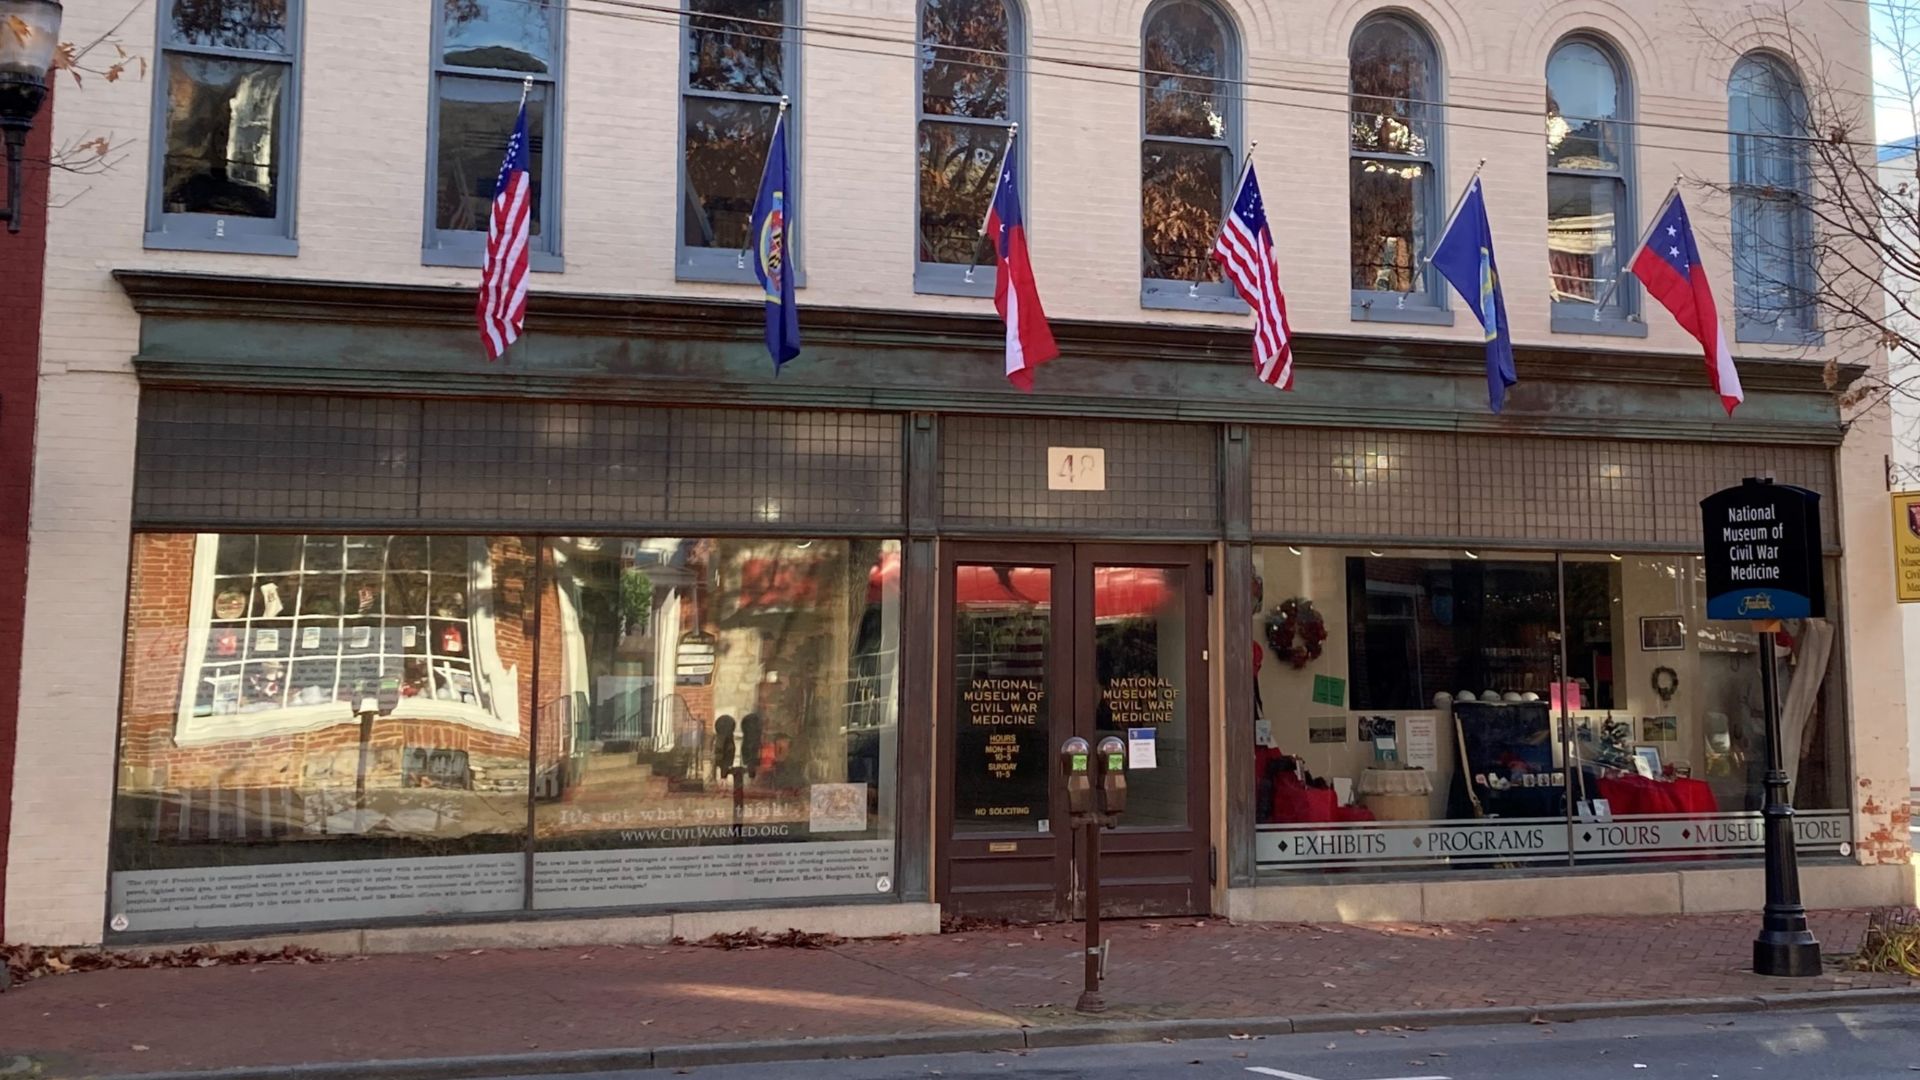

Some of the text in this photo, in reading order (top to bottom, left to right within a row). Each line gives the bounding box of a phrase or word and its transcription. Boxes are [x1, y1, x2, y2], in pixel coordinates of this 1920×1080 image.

[1729, 504, 1775, 523] National
[1723, 522, 1784, 542] Museum of
[1729, 545, 1779, 561] Civil War
[1731, 564, 1780, 581] Medicine
[972, 680, 1037, 690] NATIONAL
[1110, 678, 1173, 688] NATIONAL
[963, 691, 1045, 701] MUSEUM OF
[1103, 689, 1180, 699] MUSEUM OF
[970, 703, 1038, 713] CIVIL WAR
[1109, 701, 1174, 711] CIVIL WAR
[972, 715, 1036, 725] MEDICINE
[1112, 712, 1173, 722] MEDICINE
[990, 734, 1016, 743] HOURS
[988, 762, 1017, 770] SUNDAY
[975, 806, 1030, 816] NO SOLICITING
[560, 810, 592, 825] It's
[640, 808, 684, 822] what
[695, 808, 726, 823] you
[1294, 820, 1842, 856] EXHIBITS PROGRAMS TOURS MUSEU TORE
